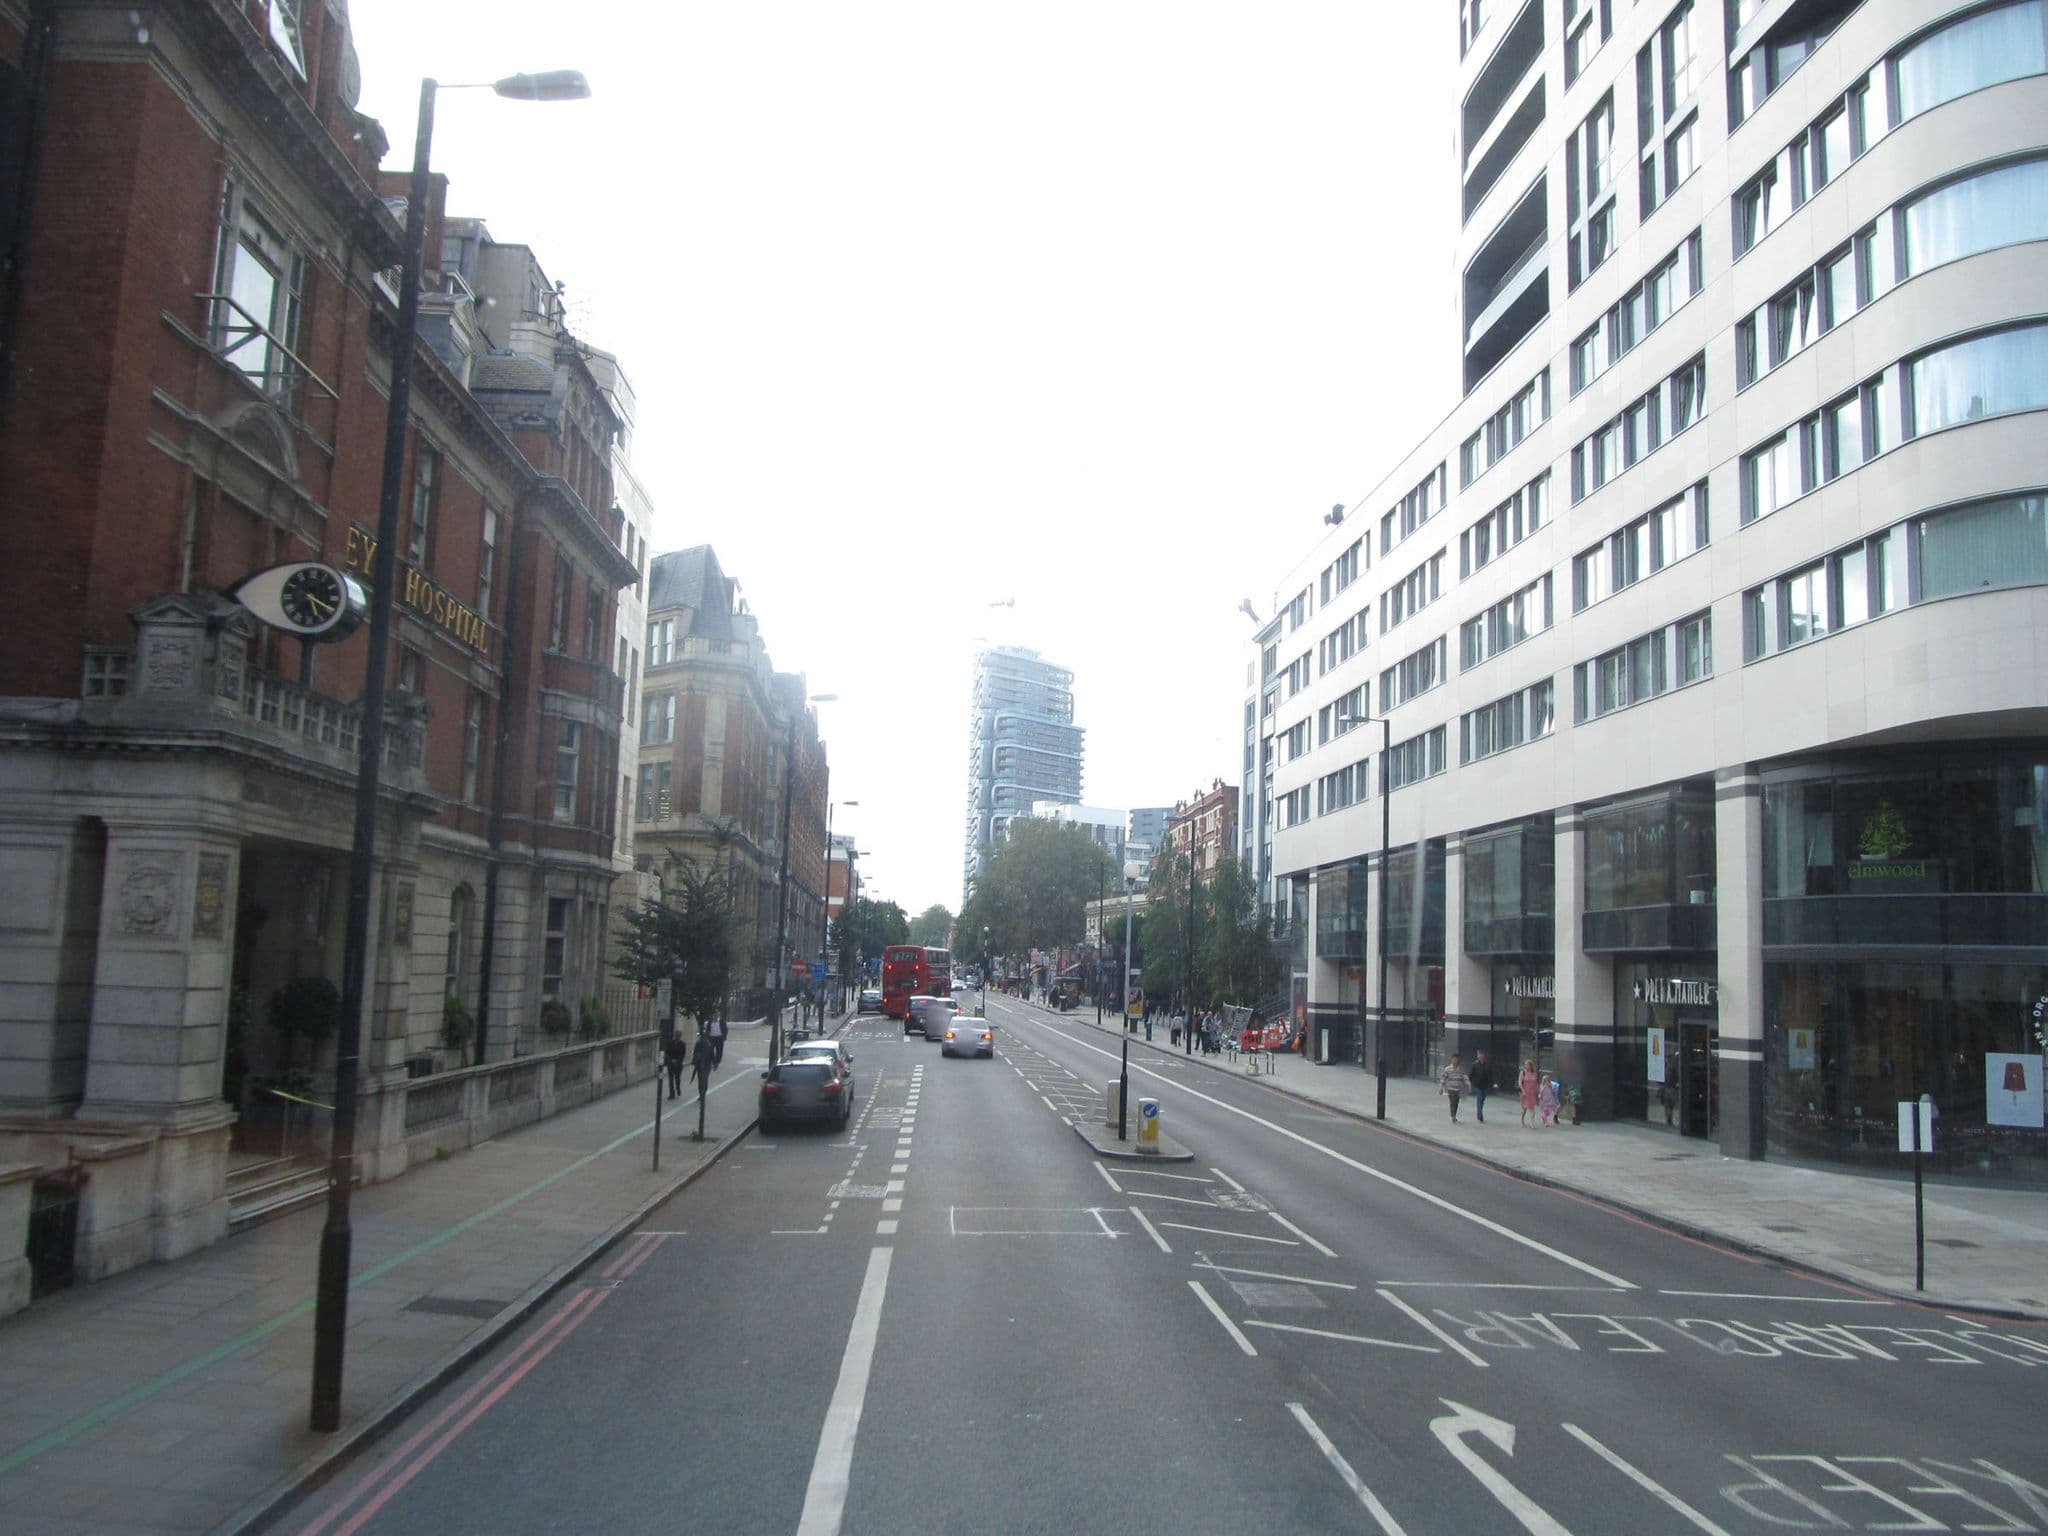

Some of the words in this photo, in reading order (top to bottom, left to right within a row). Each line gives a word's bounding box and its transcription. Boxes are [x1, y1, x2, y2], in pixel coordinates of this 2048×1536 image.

[346, 527, 377, 575] EY
[405, 567, 488, 654] HOSPITAL
[1847, 860, 1926, 879] elmwood
[1645, 977, 1665, 1003] PRET
[1433, 1307, 1784, 1358] CLEAR
[1730, 1320, 2048, 1367] CLEAR
[1719, 1453, 2048, 1532] KEEP
